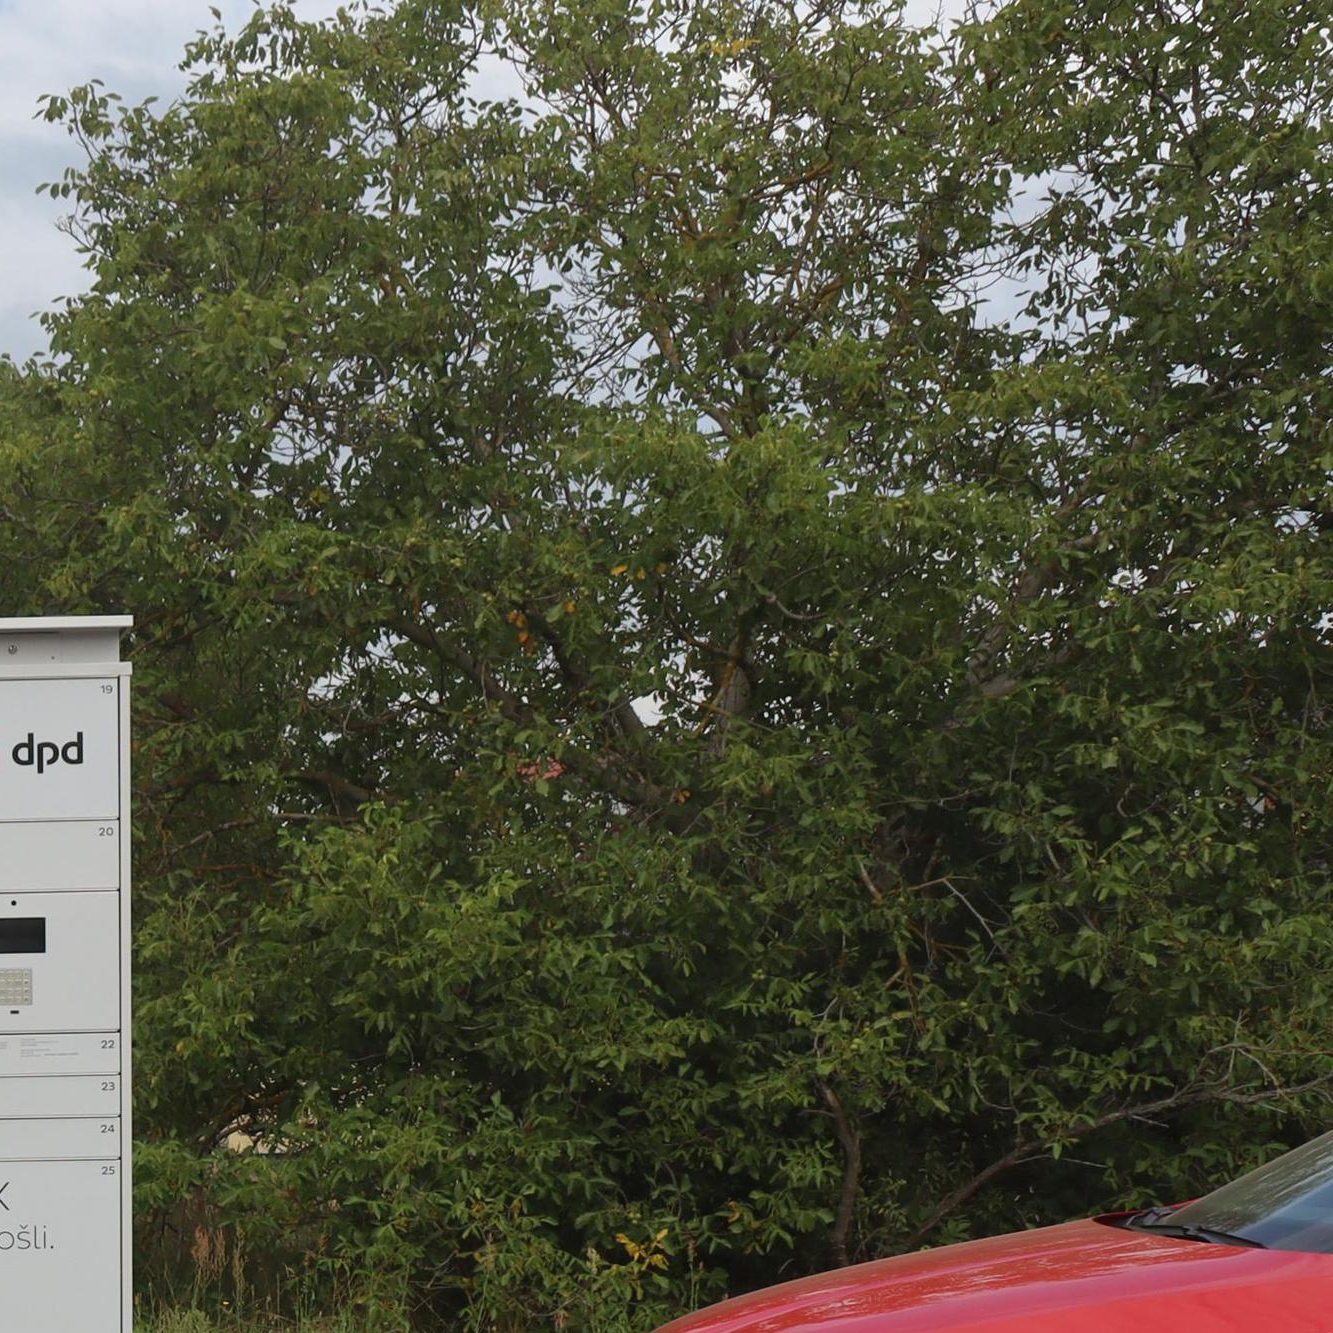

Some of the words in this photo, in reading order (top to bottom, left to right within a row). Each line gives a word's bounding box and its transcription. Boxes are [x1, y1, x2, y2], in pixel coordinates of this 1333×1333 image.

[101, 684, 114, 695] 19
[11, 731, 84, 774] dpd
[99, 827, 115, 837] 20
[100, 1039, 115, 1049] 22
[100, 1081, 115, 1092] 23
[100, 1124, 115, 1134] 24
[101, 1165, 116, 1176] 25
